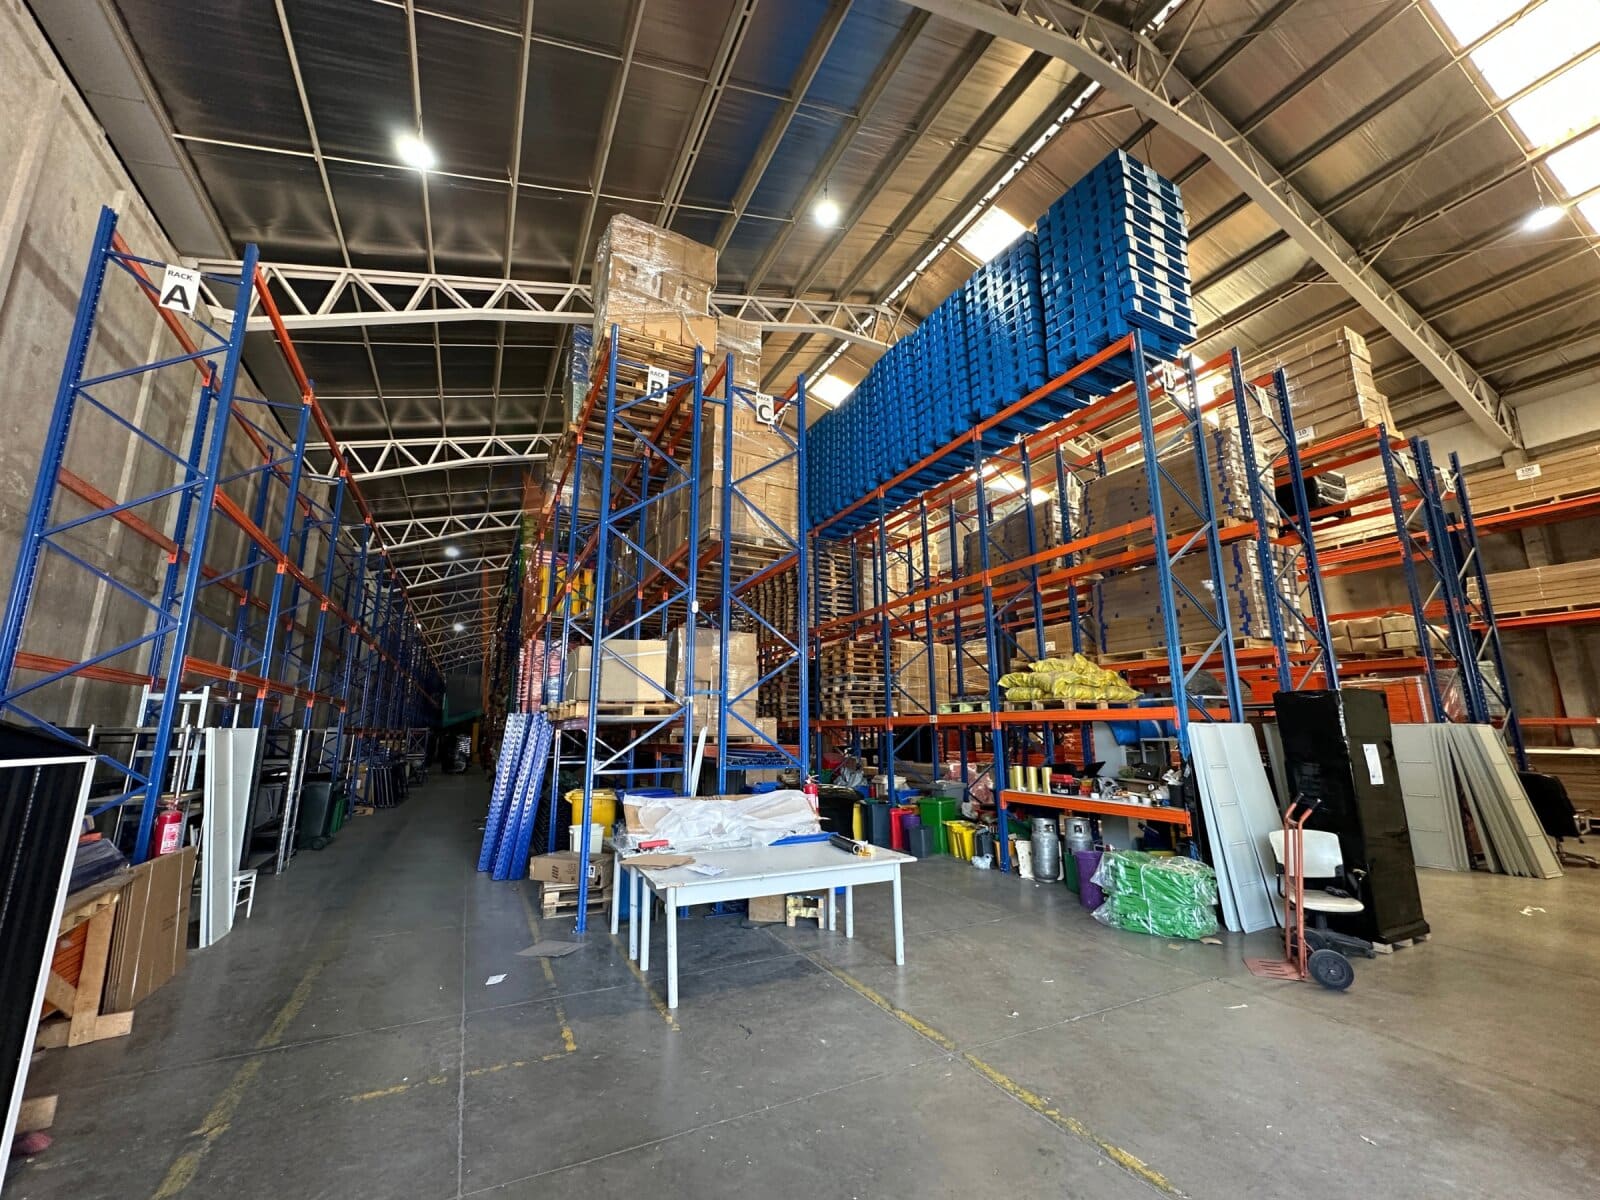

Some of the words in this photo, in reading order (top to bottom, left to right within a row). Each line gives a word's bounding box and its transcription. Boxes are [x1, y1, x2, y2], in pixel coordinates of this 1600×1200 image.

[167, 269, 193, 281] RACK
[161, 284, 191, 311] A
[650, 370, 665, 378] RACK
[650, 380, 664, 399] B
[758, 404, 771, 421] C
